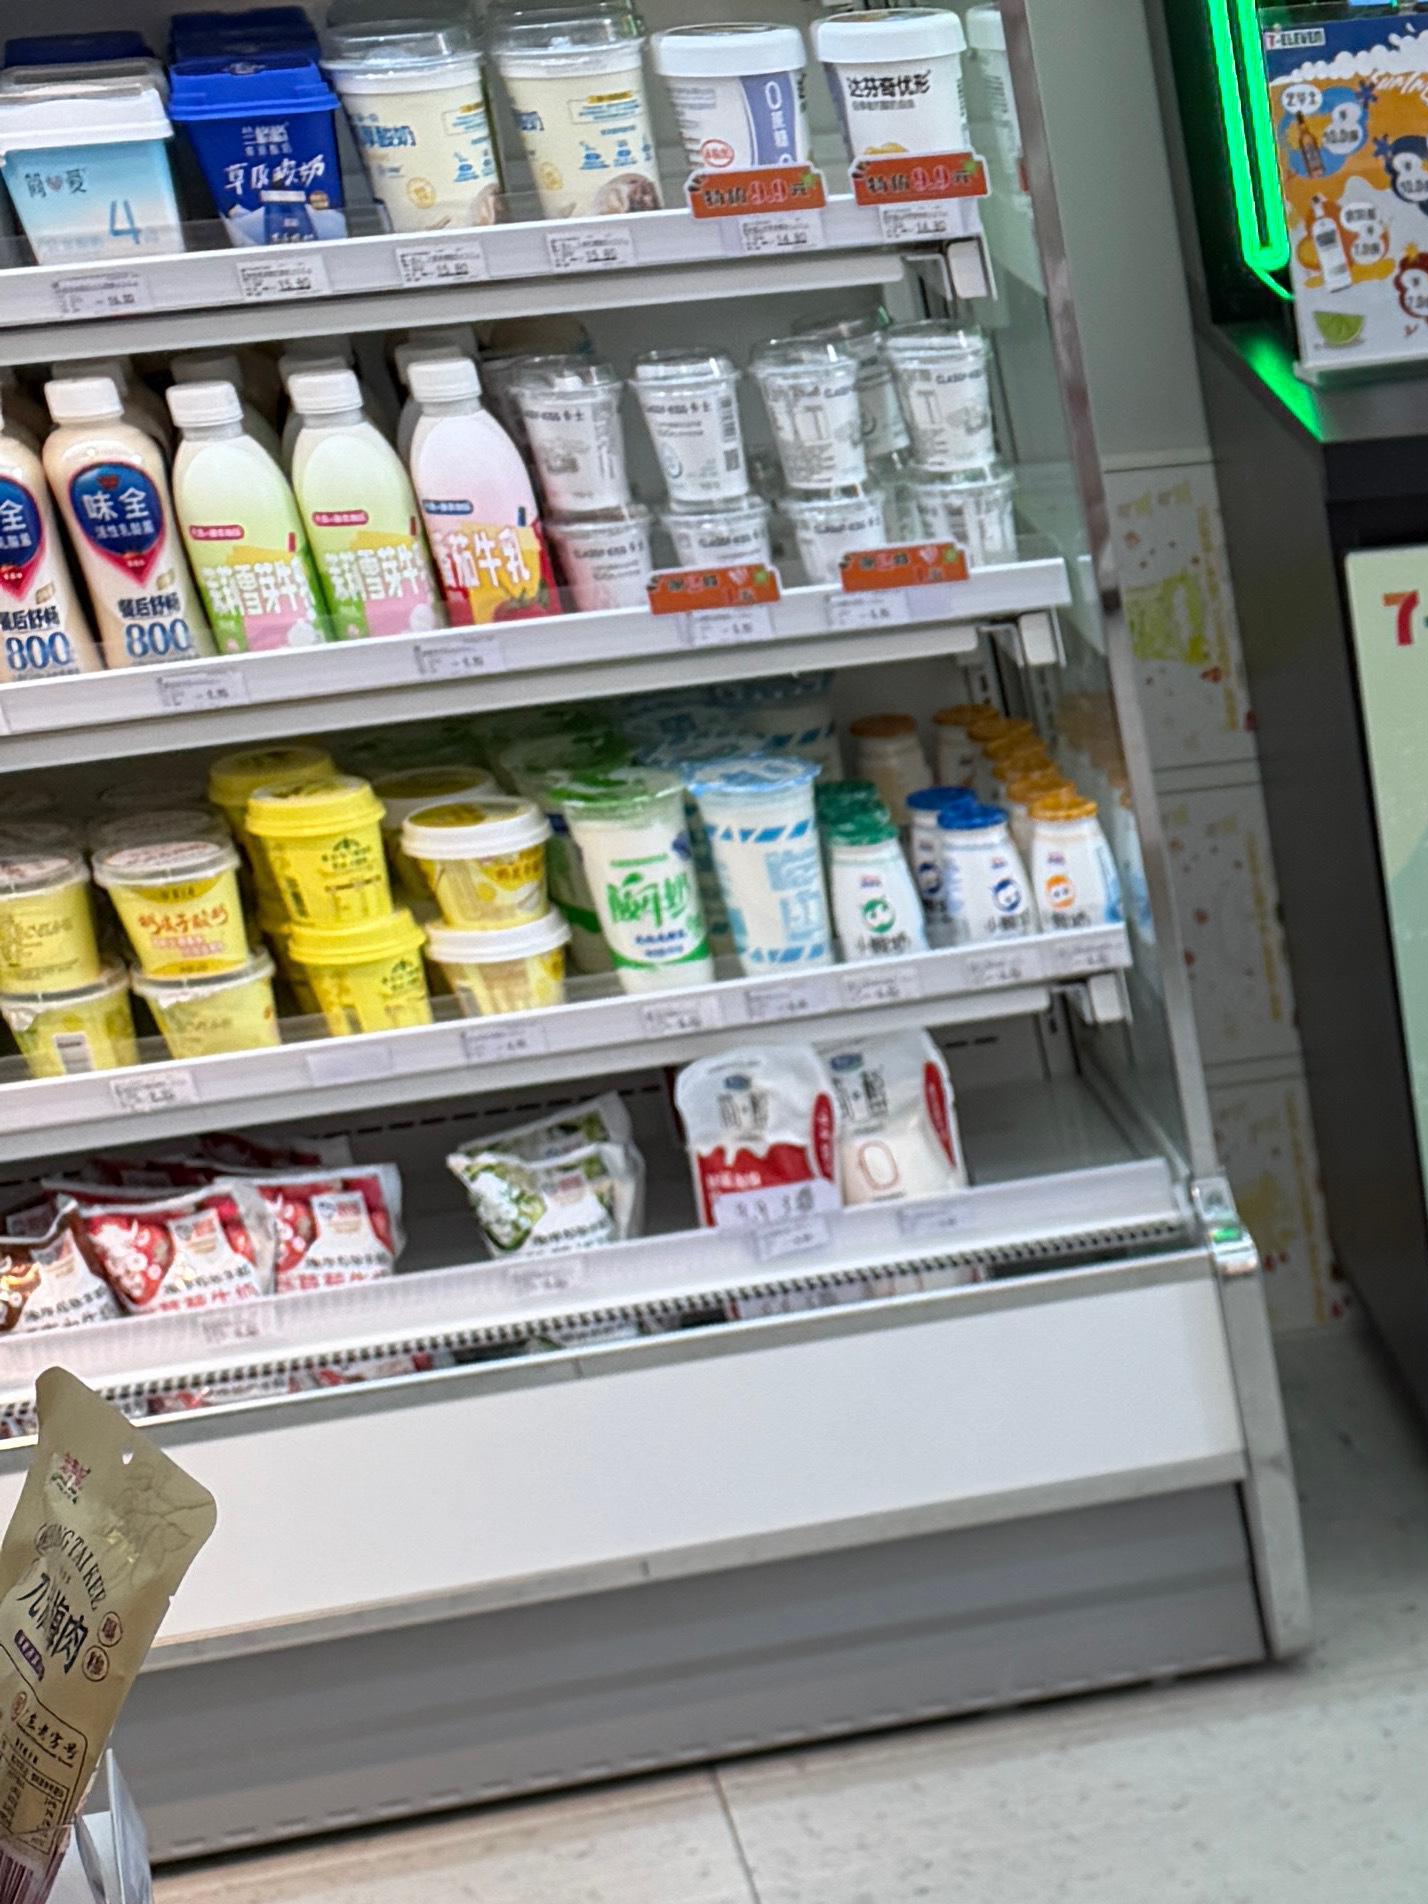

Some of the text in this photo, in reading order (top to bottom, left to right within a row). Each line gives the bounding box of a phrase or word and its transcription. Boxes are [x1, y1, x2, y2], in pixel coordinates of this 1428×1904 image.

[109, 200, 141, 245] 4
[82, 487, 150, 522] 味全
[4, 631, 71, 673] 800
[125, 618, 192, 660] 800
